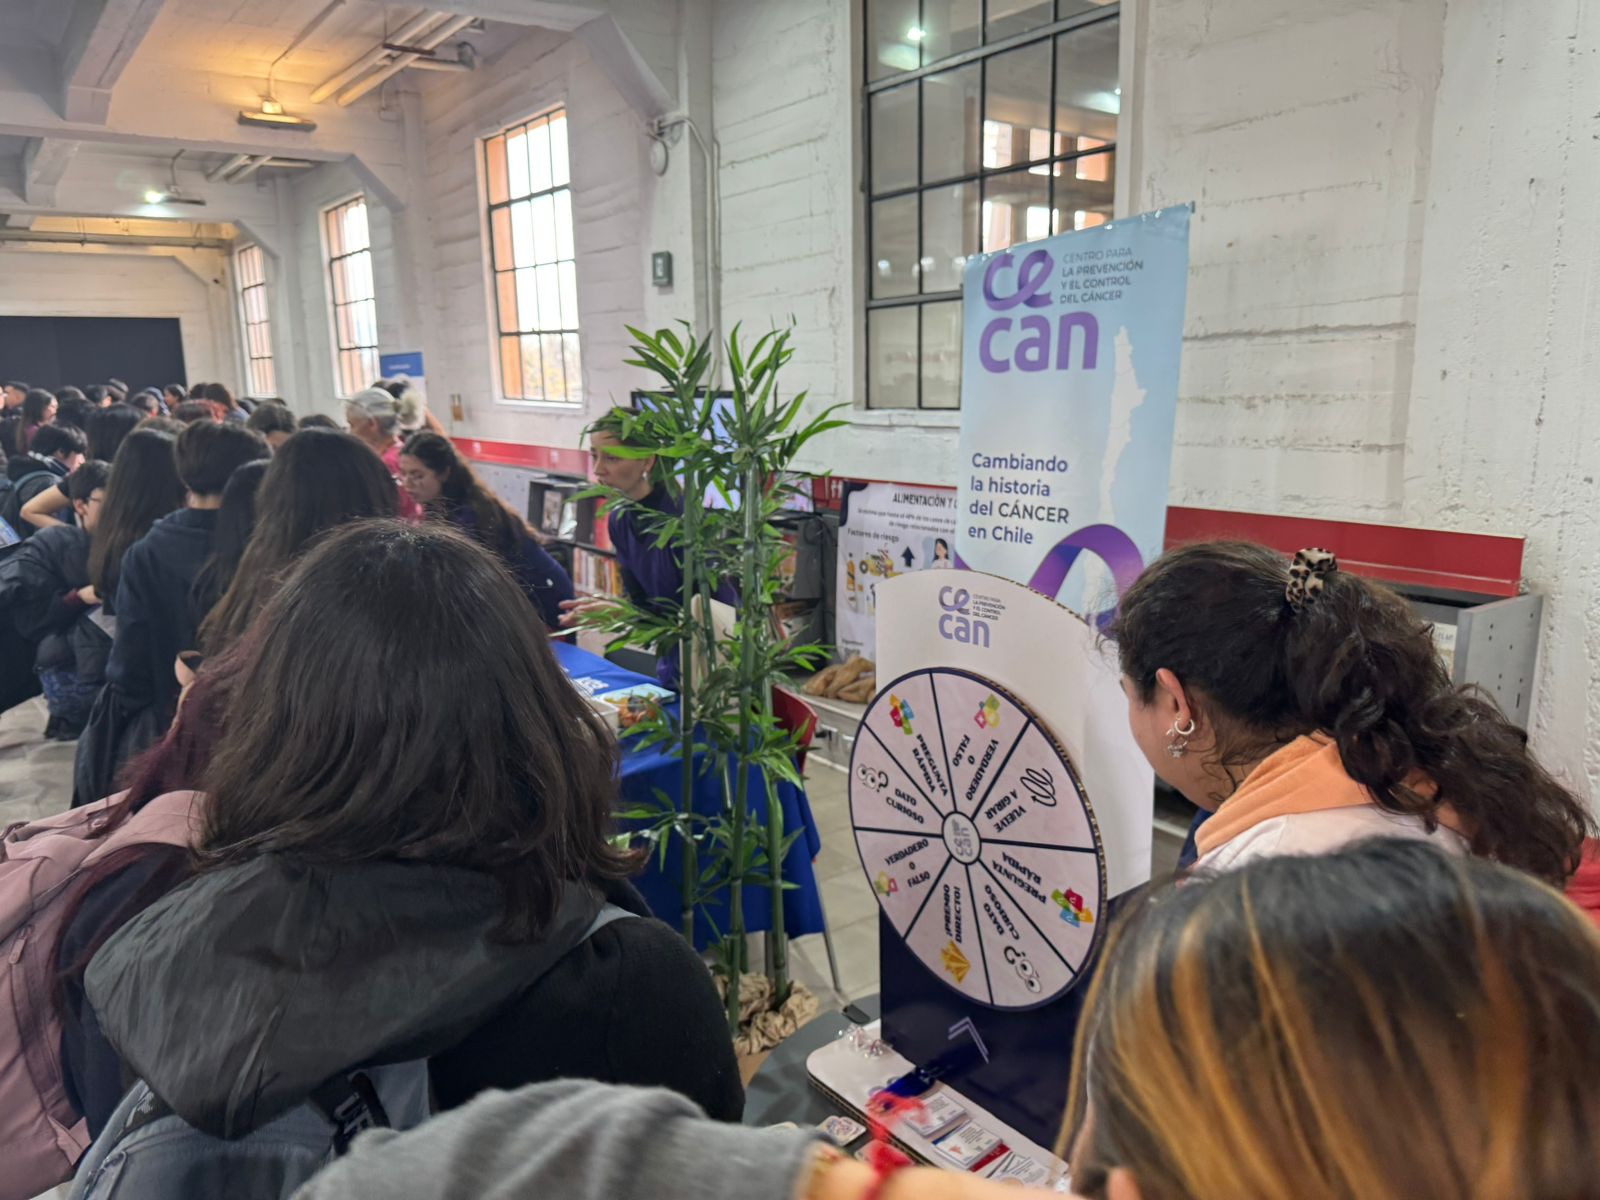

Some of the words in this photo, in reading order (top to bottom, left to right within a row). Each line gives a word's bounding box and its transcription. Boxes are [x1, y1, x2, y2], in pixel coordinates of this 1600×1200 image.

[1062, 250, 1104, 264] CENTRO
[1106, 247, 1132, 259] PARA
[1062, 267, 1074, 278] LA
[1076, 259, 1144, 275] PREVENCIÓN
[1060, 281, 1067, 290] Y
[1069, 280, 1081, 290] EL
[1082, 276, 1132, 289] CONTROL
[1060, 294, 1079, 304] DEL
[1080, 290, 1122, 303] CÁNCER
[979, 311, 1099, 374] can
[972, 452, 1068, 472] Cambiando
[970, 475, 983, 492] la
[988, 476, 1051, 497] historia
[892, 491, 946, 508] ALIMENTACIÓN
[969, 500, 993, 516] del
[998, 499, 1069, 524] CÁNCER
[968, 526, 987, 540] en
[992, 526, 1033, 544] Chile
[938, 613, 990, 648] can
[952, 734, 970, 767] FALSO
[967, 755, 975, 765] O
[916, 734, 948, 796] PREGUNTA
[966, 739, 999, 801] VERDADERO
[895, 788, 917, 806] DATO
[1010, 789, 1018, 799] A
[886, 796, 925, 824] CURIOSO
[984, 795, 1011, 820] GIRAR
[993, 805, 1027, 833] VUELVE
[884, 838, 929, 866] VERDADERO
[908, 861, 916, 870] O
[1002, 851, 1041, 885] RÁPIDA
[907, 871, 930, 888] FALSO
[992, 860, 1047, 904] PREGUNTA
[983, 902, 1005, 935] DATO
[985, 884, 1020, 940] CURIOSO
